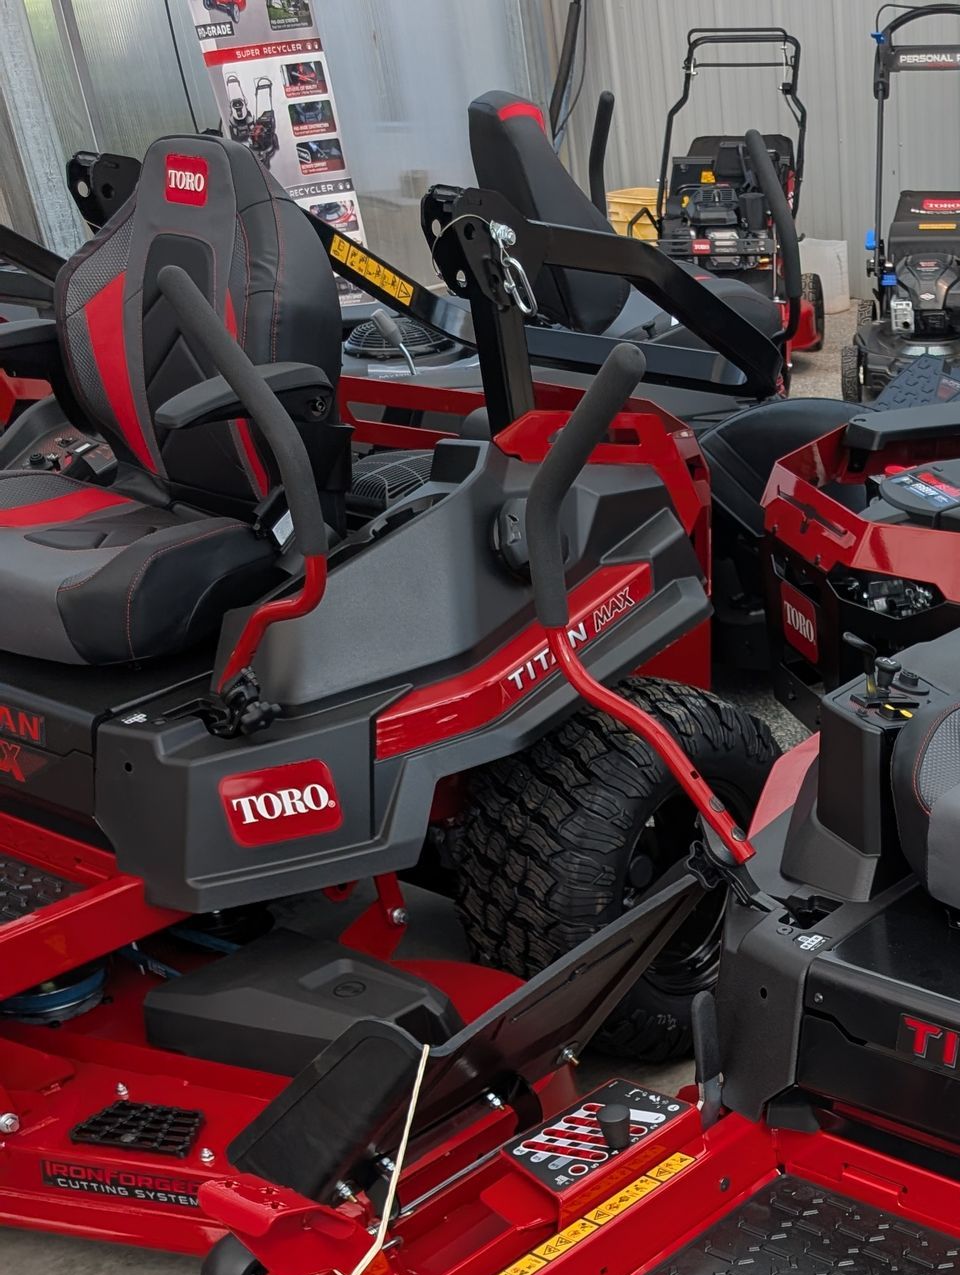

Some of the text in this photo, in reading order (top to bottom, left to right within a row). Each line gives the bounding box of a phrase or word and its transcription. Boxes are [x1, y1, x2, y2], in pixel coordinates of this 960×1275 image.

[235, 43, 303, 59] SUPER RECYCLER
[899, 54, 954, 63] PERSONAL
[167, 169, 205, 192] TORO
[289, 183, 334, 198] RECYCLER
[783, 600, 815, 643] TORO
[507, 586, 635, 691] TITN MAX
[231, 783, 331, 825] TORO
[56, 1177, 129, 1197] CUTTING
